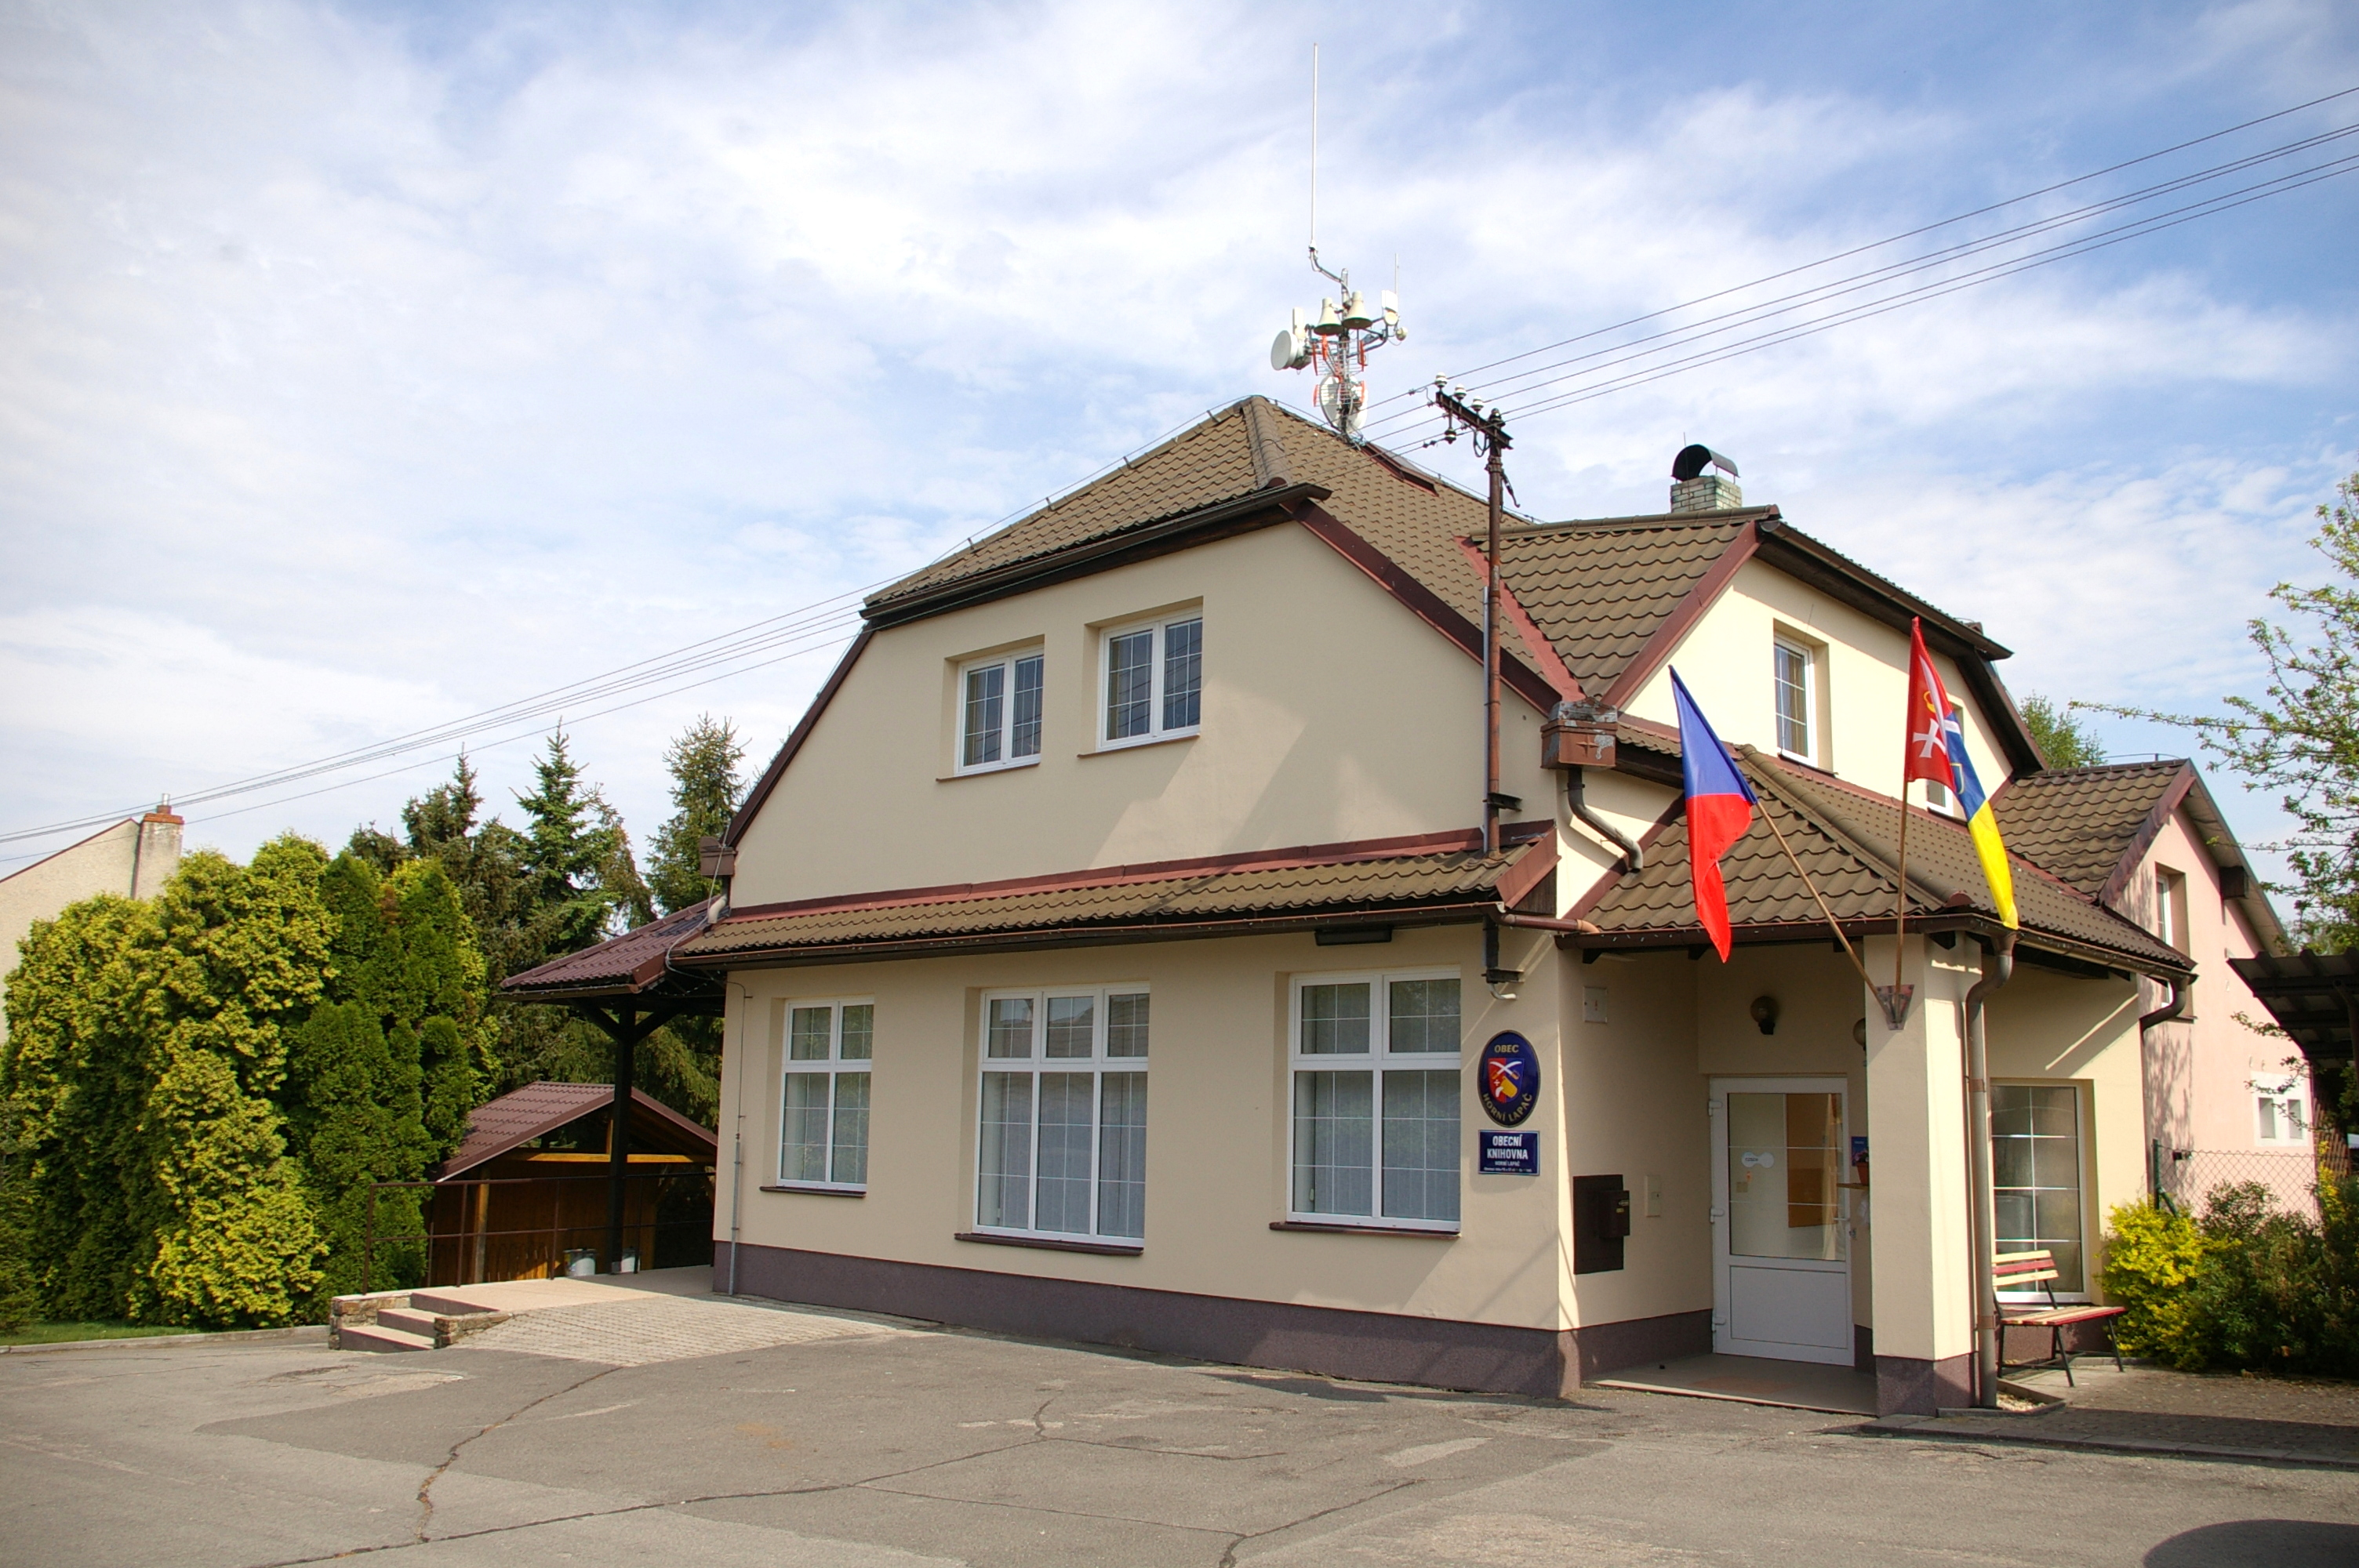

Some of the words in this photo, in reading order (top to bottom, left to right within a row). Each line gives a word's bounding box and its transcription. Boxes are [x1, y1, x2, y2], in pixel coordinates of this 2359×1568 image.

[1494, 1044, 1519, 1053] OBEC
[1482, 1093, 1506, 1121] HORNÍ
[1508, 1092, 1532, 1122] LAPAČ
[1492, 1134, 1523, 1147] OBECNÍ
[1486, 1148, 1528, 1160] KNIHOVNA
